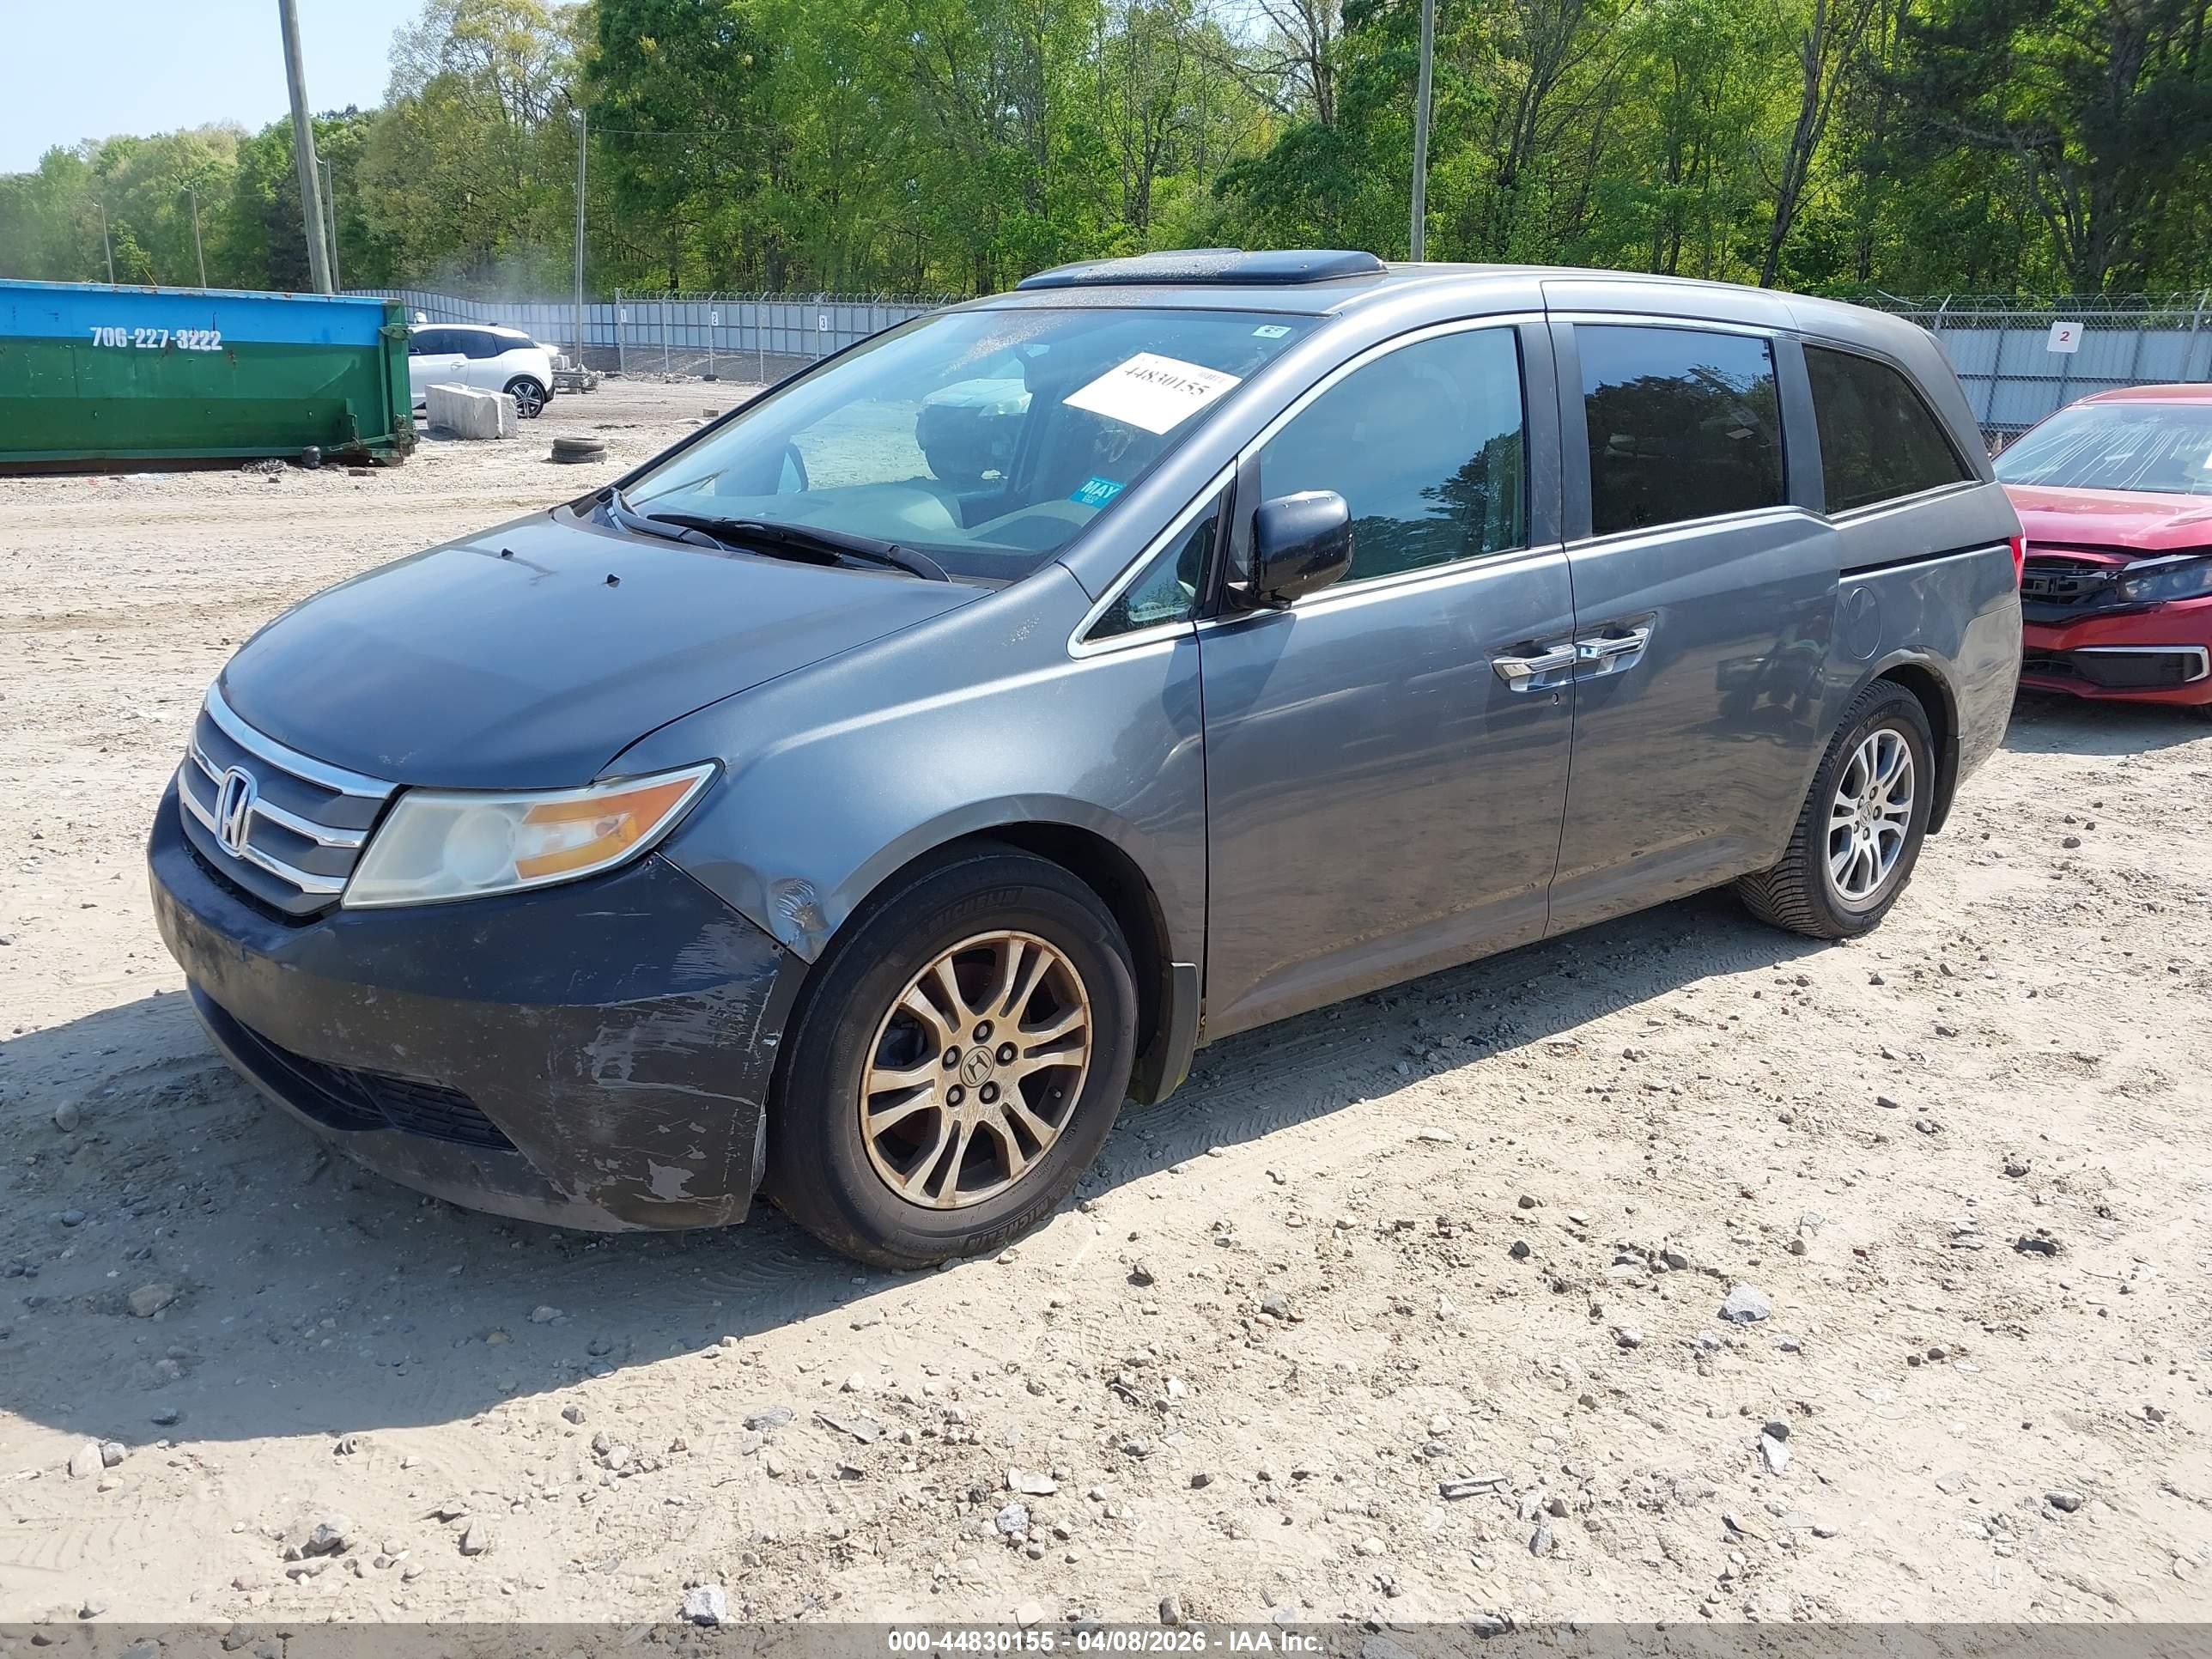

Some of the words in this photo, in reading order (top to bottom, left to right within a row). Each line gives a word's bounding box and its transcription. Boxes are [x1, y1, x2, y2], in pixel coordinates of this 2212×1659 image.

[820, 318, 826, 328] 3
[89, 327, 223, 351] 706-227-3222
[2059, 331, 2070, 342] 2
[1124, 367, 1211, 395] 44830155
[1080, 480, 1121, 498] MAY
